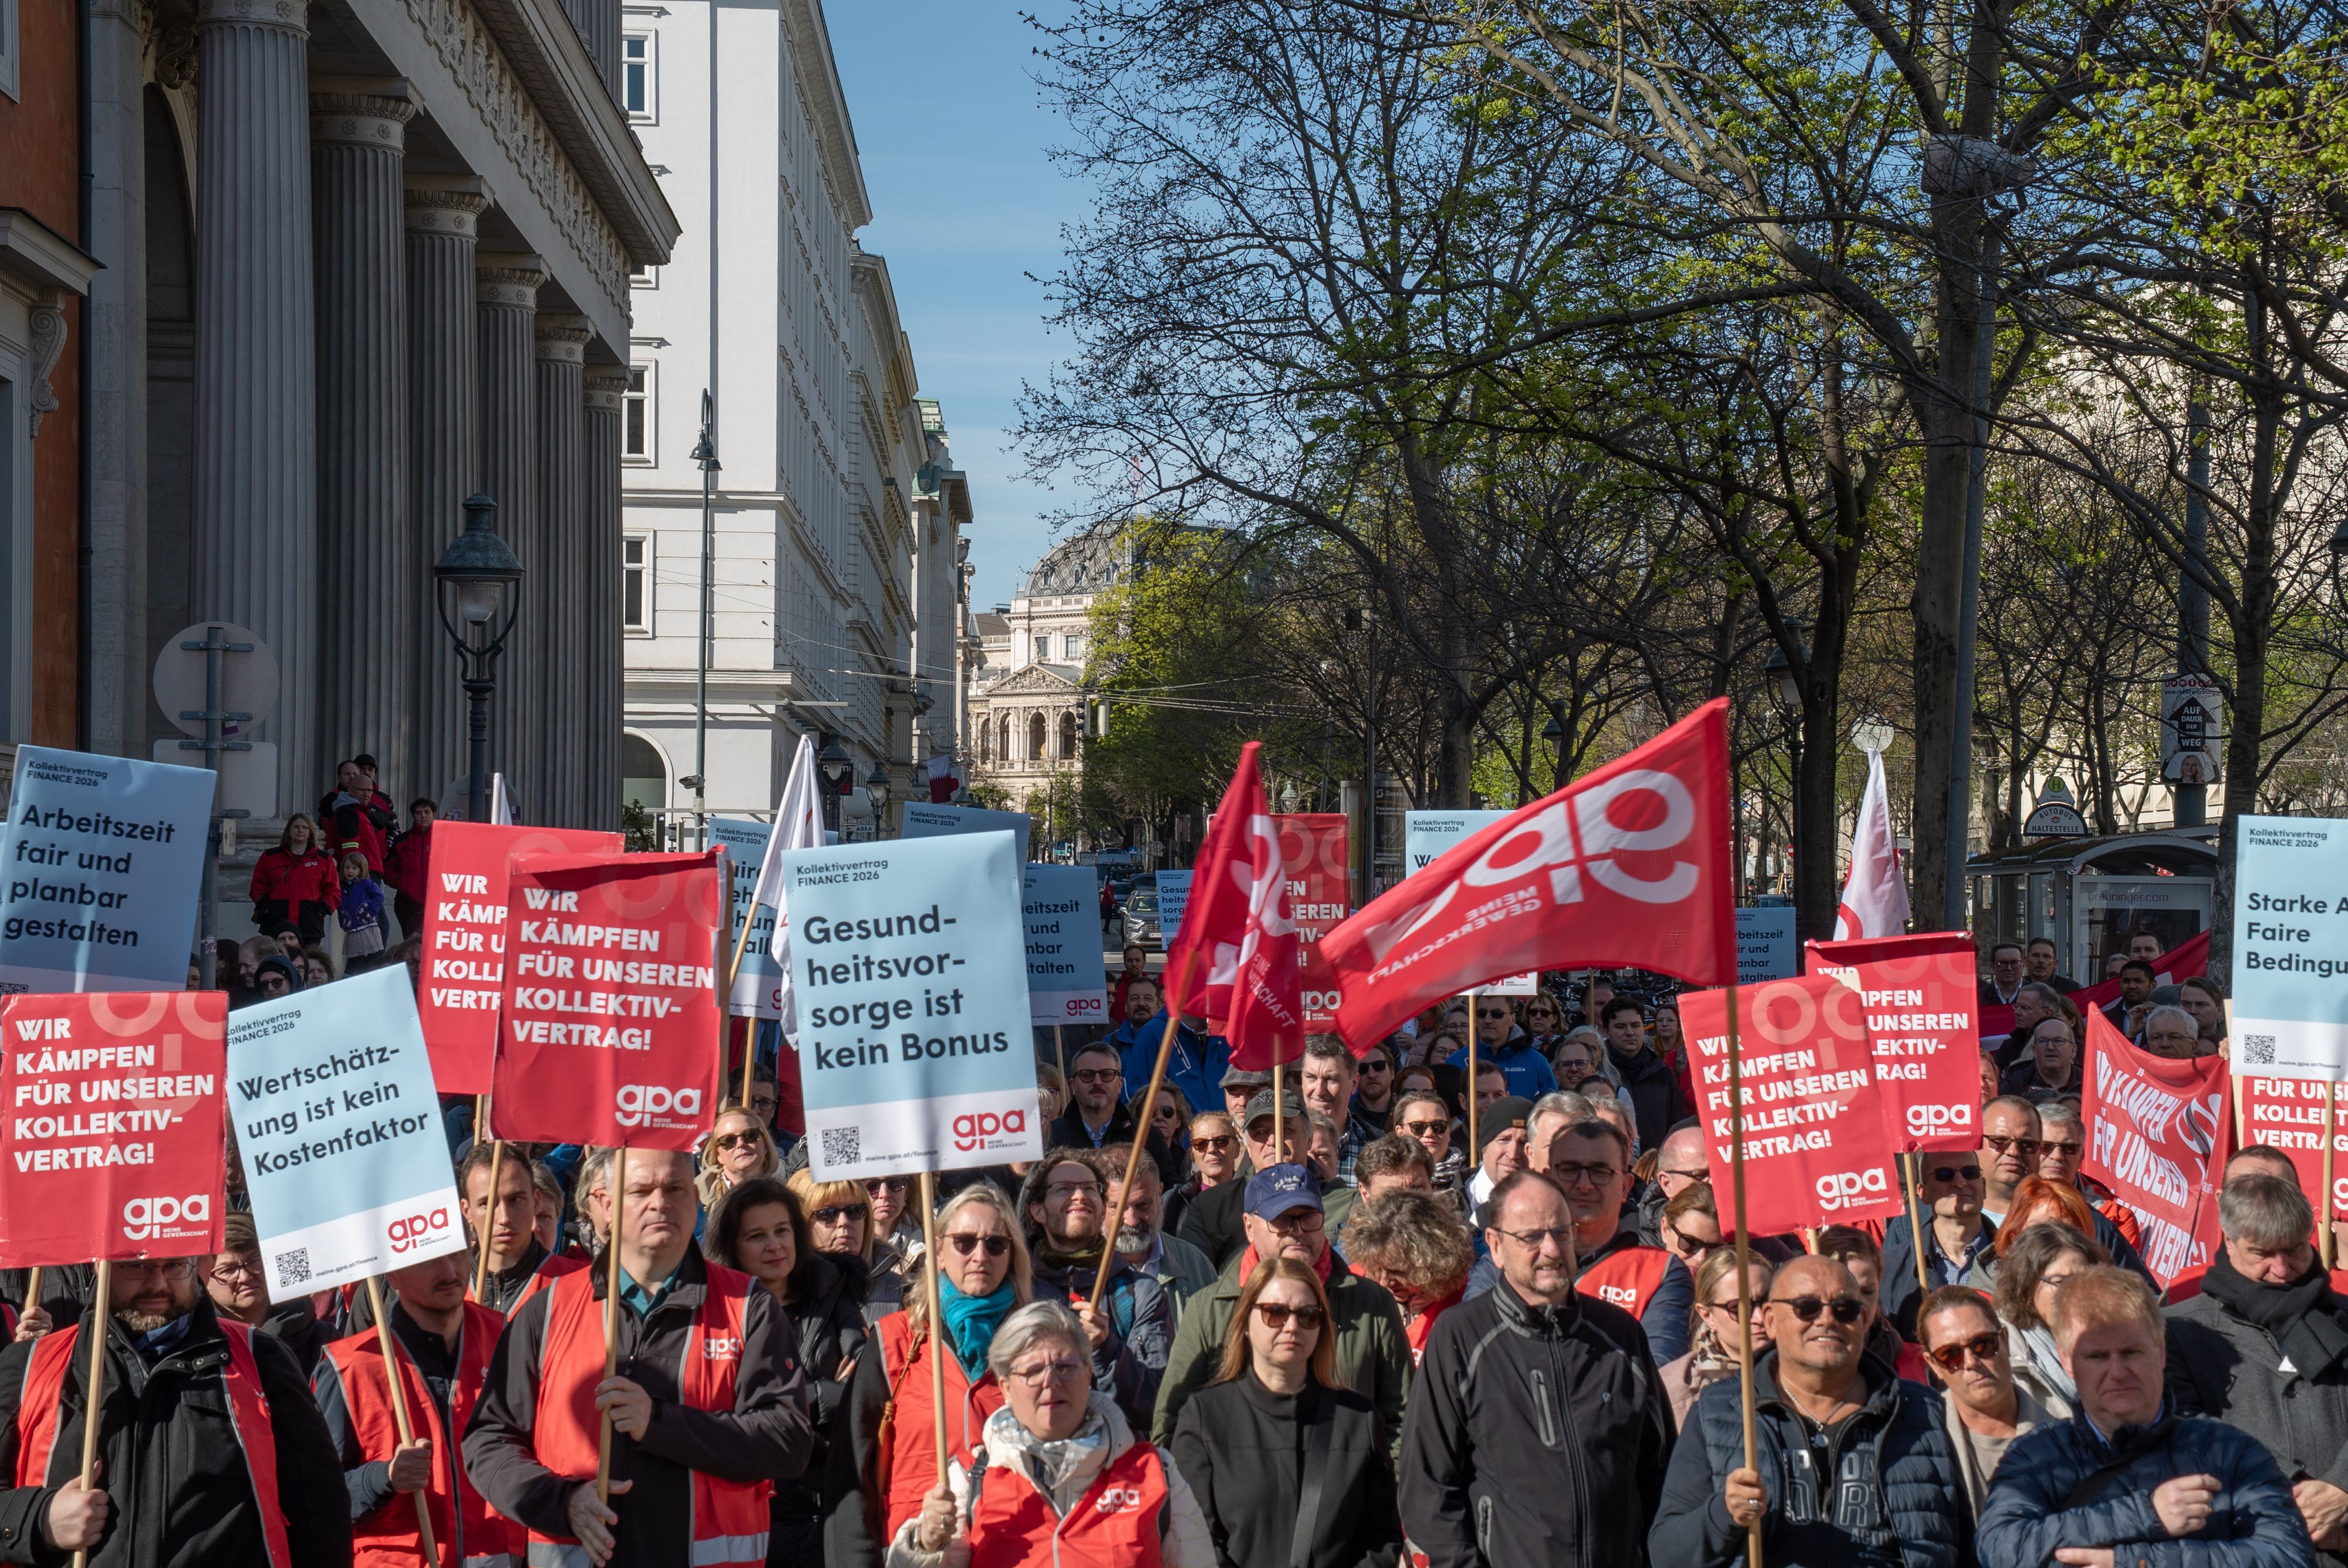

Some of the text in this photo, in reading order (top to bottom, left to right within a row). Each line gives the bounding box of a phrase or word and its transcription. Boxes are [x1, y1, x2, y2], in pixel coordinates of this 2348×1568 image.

[27, 771, 98, 786] FINANCE 2026
[29, 761, 108, 779] Kollektivvertrag
[20, 805, 175, 843] Arbeitszeit
[910, 810, 961, 822] Kollektivvertrag
[910, 817, 938, 826] FINANCE
[2039, 807, 2074, 821] AUTOBUS
[715, 834, 744, 843] FINANCE
[716, 827, 767, 840] Kollektivvertrag
[2249, 829, 2327, 840] Kollektivvertrag
[2249, 837, 2319, 848] FINANCE 2026
[16, 840, 132, 874] fair und
[797, 859, 889, 875] Kollektivvertrag
[441, 873, 488, 894] WIR
[798, 870, 880, 887] FINANCE 2026
[9, 877, 127, 909] planbar
[524, 887, 578, 913] WIR
[2088, 892, 2168, 904] breuninger.com
[2247, 893, 2327, 914] Starke
[4, 917, 139, 947] gestalten
[520, 918, 660, 952] KÄMPFEN
[804, 904, 957, 945] Gesund-
[1030, 921, 1060, 934] und
[2247, 922, 2310, 942] Faire
[436, 928, 483, 952] FÜR
[744, 937, 773, 955] all
[1749, 944, 1769, 953] und
[517, 951, 714, 989] FÜR UNSEREN
[807, 952, 966, 986] heitsvor-
[514, 987, 682, 1019] KOLLEKTIV-
[811, 988, 964, 1030] sorge ist
[1066, 999, 1101, 1016] gpa
[15, 1018, 71, 1041] WIR
[228, 1020, 295, 1047] FINANCE 2026
[1868, 1013, 1969, 1031] UNSEREN
[512, 1020, 652, 1050] VERTRAG!
[1696, 1034, 1745, 1056] WIR
[16, 1045, 154, 1074] KÄMPFEN
[815, 1031, 1008, 1070] kein Bonus
[236, 1045, 400, 1101] Wertschätz-
[1702, 1049, 1816, 1084] KÄMPFEN
[2278, 1060, 2341, 1069] meine.gpa.at/finance
[16, 1074, 214, 1107] FÜR UNSEREN
[1708, 1068, 1869, 1111] FÜR UNSEREN
[2253, 1077, 2295, 1099] FÜR
[248, 1081, 400, 1139] ung ist kein
[615, 1084, 701, 1127] gpa
[15, 1109, 183, 1140] KOLLEKTIV-
[652, 1122, 699, 1130] GEWERKSCHAFT
[953, 1110, 1025, 1151] gpa
[1712, 1100, 1848, 1137] KOLLEKTIV-
[1906, 1104, 1972, 1137] gpa
[254, 1113, 429, 1176] Kostenfaktor
[865, 1149, 938, 1162] meine.gpa.at/finance
[1717, 1129, 1832, 1164] VERTRAG!
[14, 1143, 154, 1172] VERTRAG!
[1816, 1167, 1888, 1211] gpa
[1851, 1197, 1889, 1207] GEWERKSCHAFT
[123, 1194, 209, 1240] gpa
[387, 1207, 449, 1253] gpa
[316, 1256, 378, 1278] meine.gpa.at/finance
[703, 1337, 740, 1360] gpa
[1096, 1488, 1140, 1513] gpa
